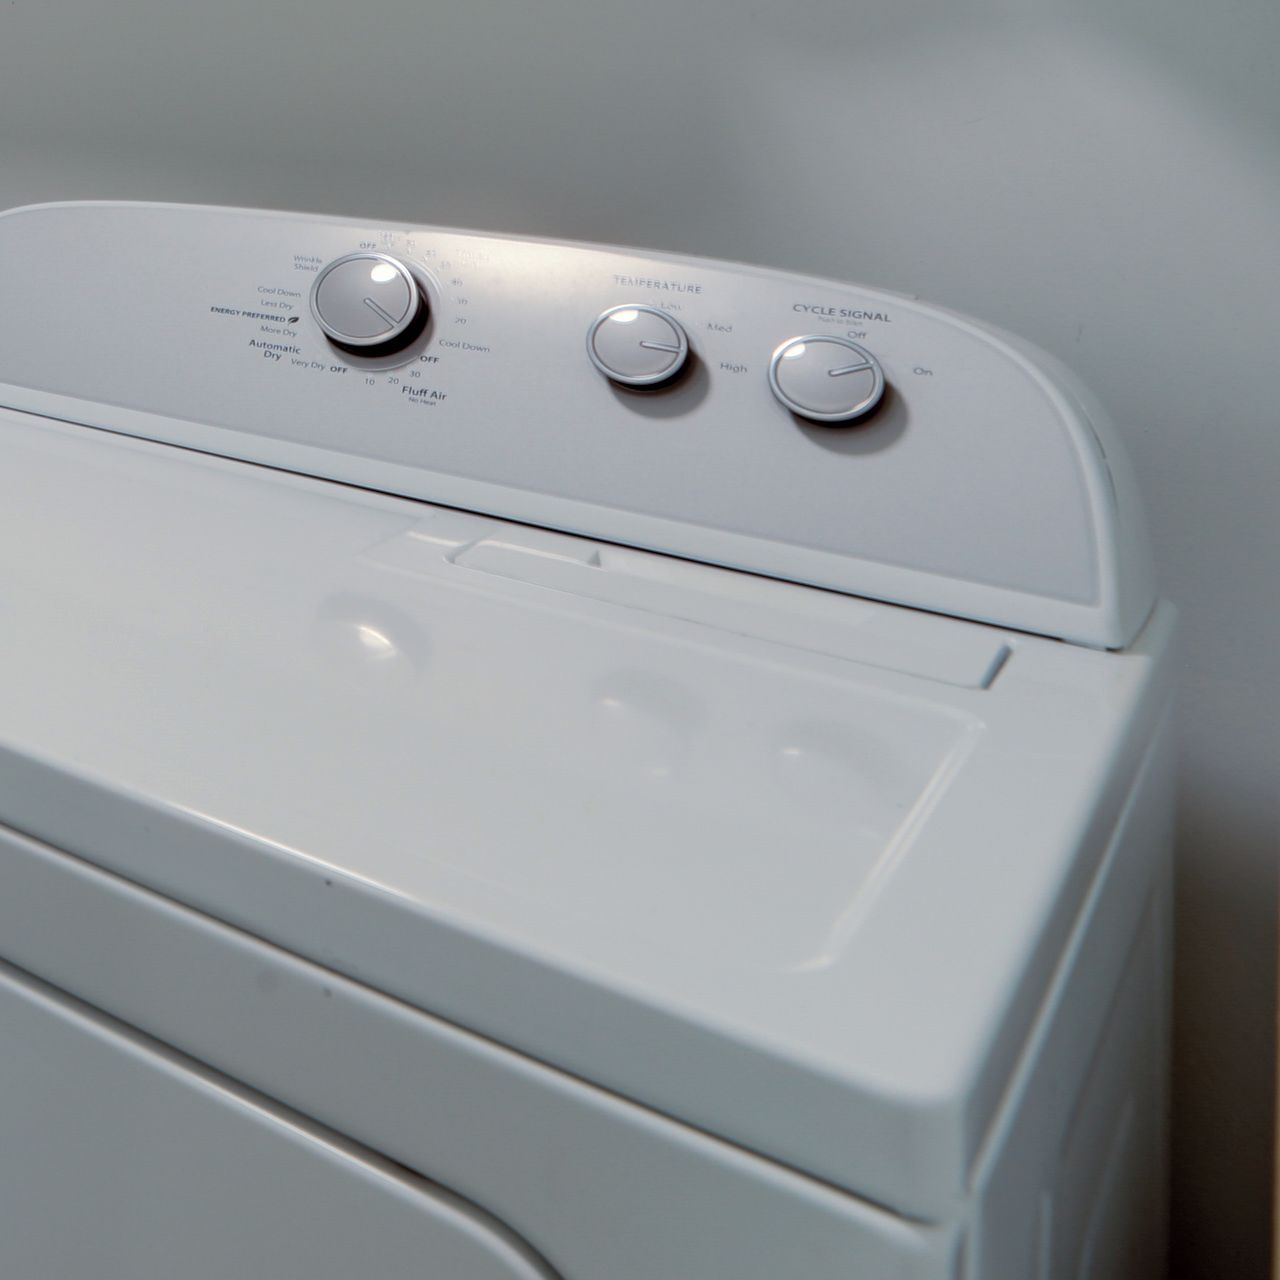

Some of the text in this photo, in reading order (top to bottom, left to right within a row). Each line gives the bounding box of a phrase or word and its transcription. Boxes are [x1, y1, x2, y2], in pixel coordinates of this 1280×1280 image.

[293, 254, 323, 265] Wrinkle
[293, 262, 320, 273] Shield
[613, 273, 704, 295] TEMPERATURE
[257, 285, 302, 298] Cool Down
[260, 298, 294, 311] Less Dry
[209, 306, 287, 324] ENERGY PREFERRED
[792, 303, 837, 317] CYCLE
[839, 308, 892, 323] SIGNAL
[260, 324, 298, 338] More Dry
[706, 322, 733, 333] Med
[847, 329, 868, 340] Off
[248, 338, 302, 356] Automatic
[438, 338, 491, 353] Cool Down
[263, 349, 282, 362] Dry
[419, 354, 440, 364] OFF
[290, 357, 327, 372] Very Dry
[329, 364, 349, 375] OFF
[720, 361, 749, 376] High
[408, 369, 421, 379] 30
[913, 367, 934, 377] On
[363, 377, 376, 387] 10
[387, 376, 400, 386] 20
[401, 384, 448, 402] Fluff Air
